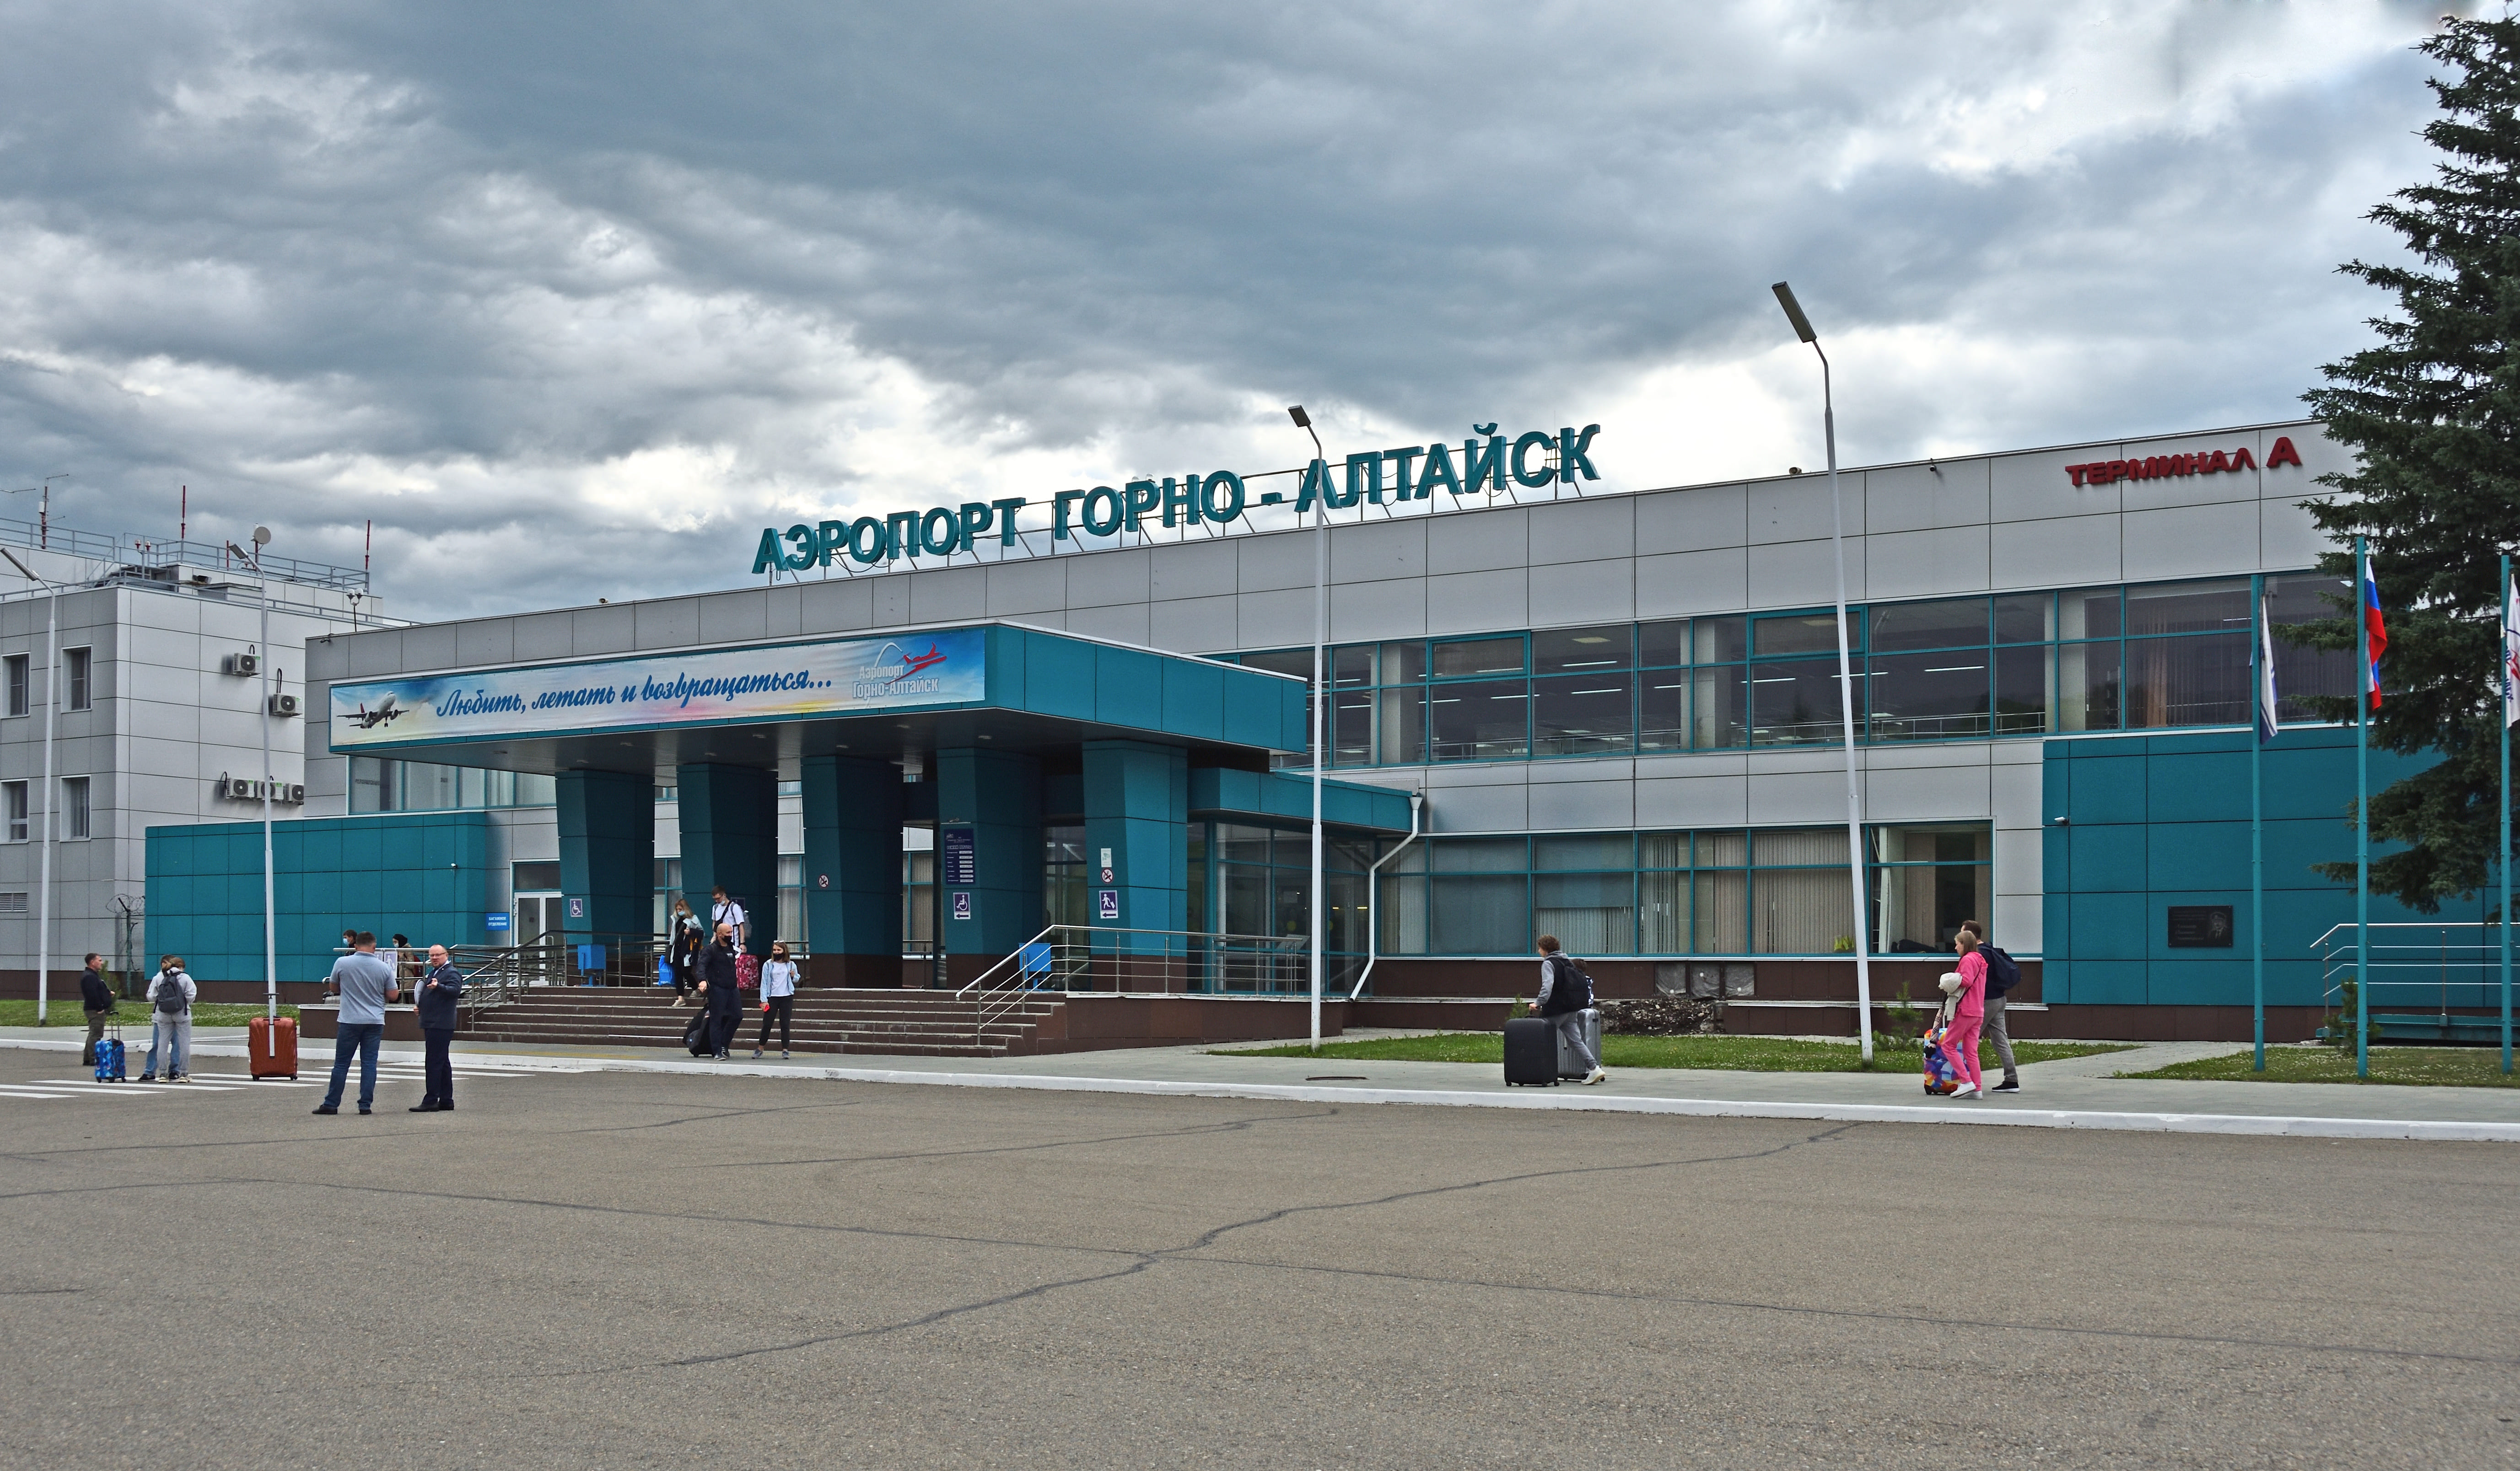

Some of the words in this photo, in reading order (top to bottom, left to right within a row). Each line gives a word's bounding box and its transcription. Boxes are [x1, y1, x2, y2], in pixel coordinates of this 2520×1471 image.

[2065, 447, 2256, 486] ТЕРМИНАЛ
[2266, 436, 2302, 468] А
[751, 497, 1026, 574] АЭРОПОРТ
[1054, 470, 1245, 540] ГОРНО
[1294, 422, 1601, 513] АЛТАЙСК
[436, 688, 527, 717] Любить,
[531, 685, 615, 710] летать
[620, 685, 636, 703] и
[641, 669, 832, 708] возвращаться...
[852, 675, 939, 700] Горно-Алтайск
[859, 665, 905, 681] Аэропорт
